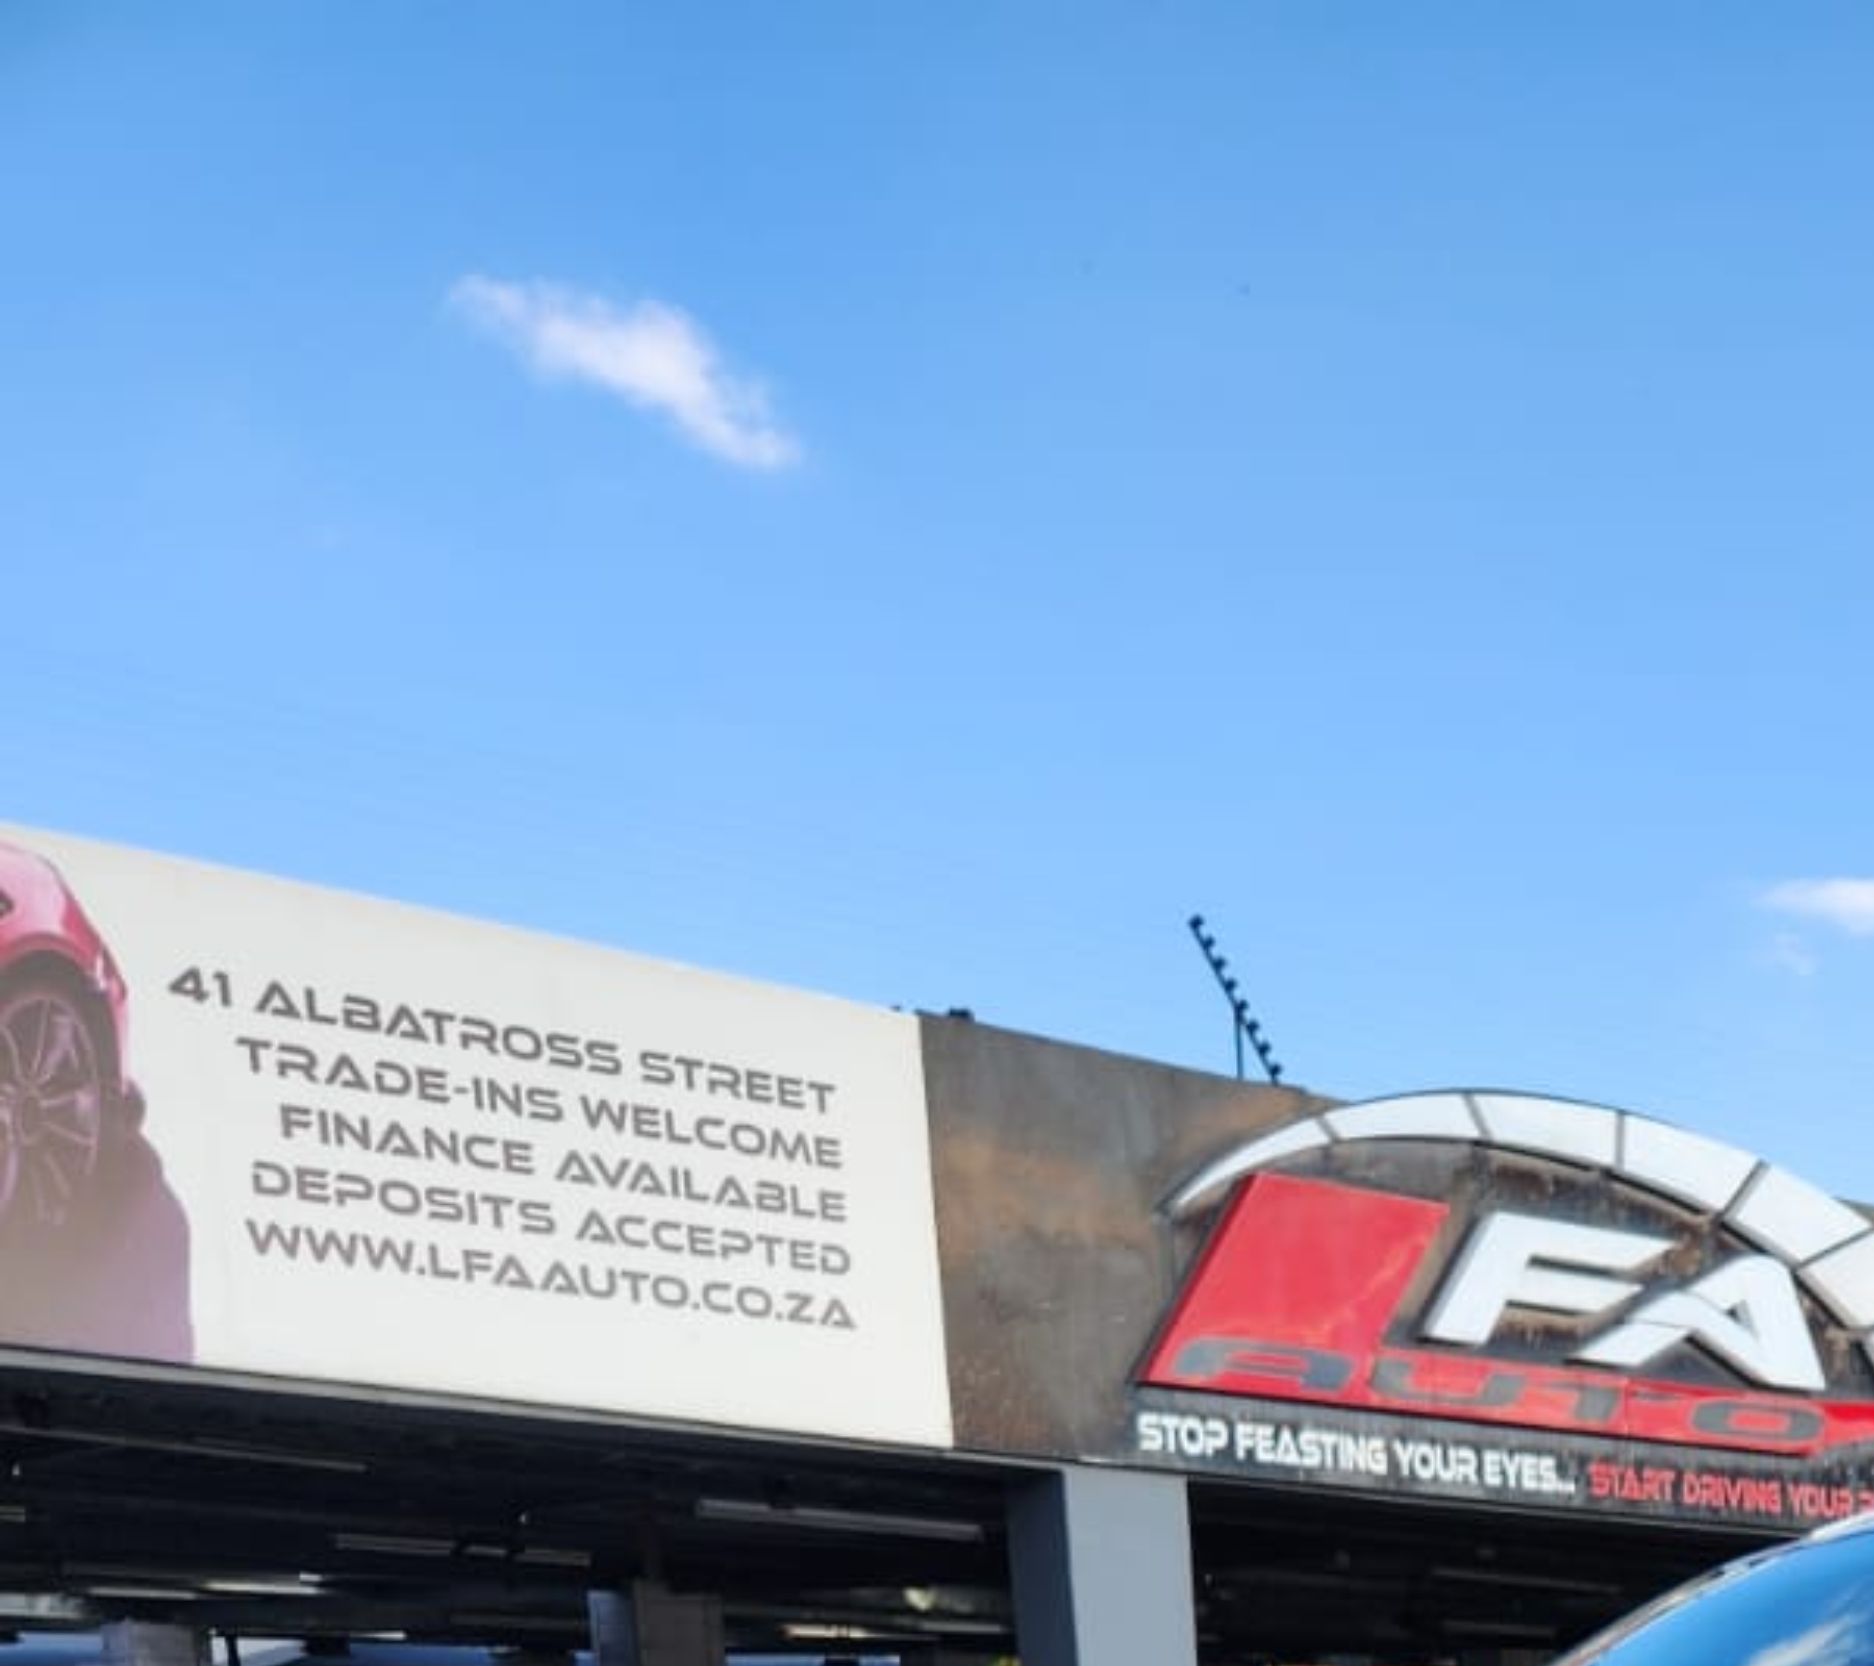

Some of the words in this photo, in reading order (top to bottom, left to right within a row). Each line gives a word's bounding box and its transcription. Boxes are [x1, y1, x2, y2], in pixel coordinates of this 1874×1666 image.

[168, 967, 231, 1008] 41
[254, 980, 622, 1076] ALBATROSS
[640, 1051, 836, 1114] STREET
[235, 1036, 563, 1123] TRADE-INS
[580, 1094, 842, 1169] WELCOME
[251, 1160, 556, 1235] DEPOSITS
[575, 1209, 852, 1275] ACCEPTED
[280, 1104, 535, 1174] FINANCE
[555, 1150, 847, 1223] AVAILABLE
[245, 1219, 856, 1330] WWW.LFAAUTO.CO.ZA
[1173, 1338, 1828, 1452] AUTO
[1137, 1413, 1228, 1455] STOP
[1234, 1423, 1388, 1475] FEASTING
[1393, 1440, 1478, 1484] YOUR
[1588, 1460, 1675, 1502] START
[1683, 1472, 1781, 1514] DRIVING
[1789, 1483, 1854, 1517] YOUR
